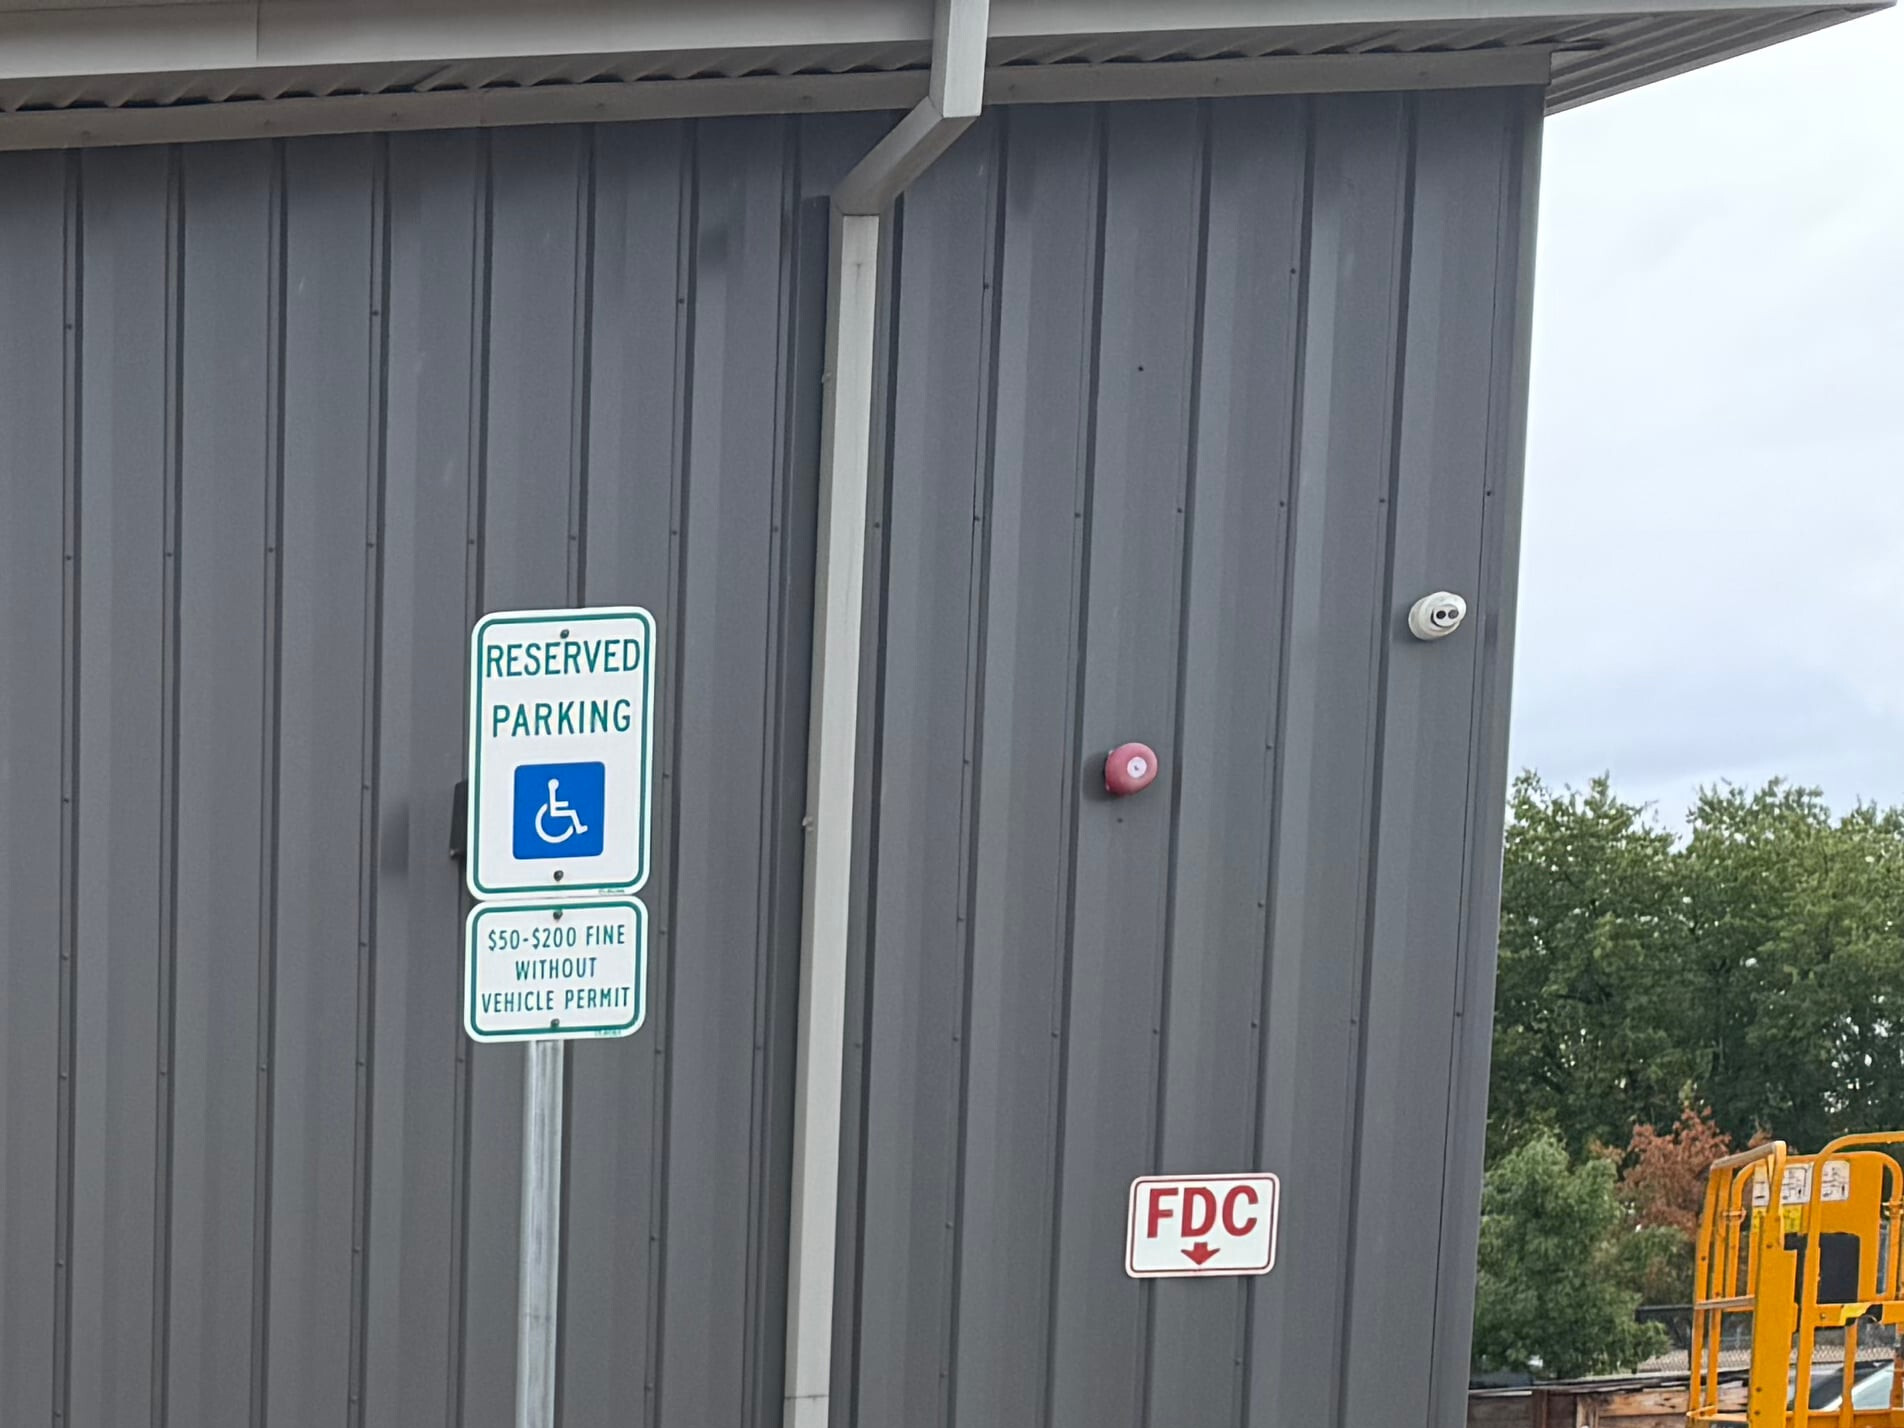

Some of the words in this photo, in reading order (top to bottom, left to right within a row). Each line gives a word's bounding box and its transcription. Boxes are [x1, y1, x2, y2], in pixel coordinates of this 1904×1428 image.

[486, 638, 641, 678] RESERVED
[492, 698, 632, 738] PARKING
[488, 926, 577, 952] $50-$200
[585, 924, 626, 946] FINE
[515, 956, 598, 981] WITHOUT
[482, 990, 555, 1014] VEHICLE
[564, 986, 631, 1010] PERMIT
[1146, 1184, 1259, 1239] FDC
